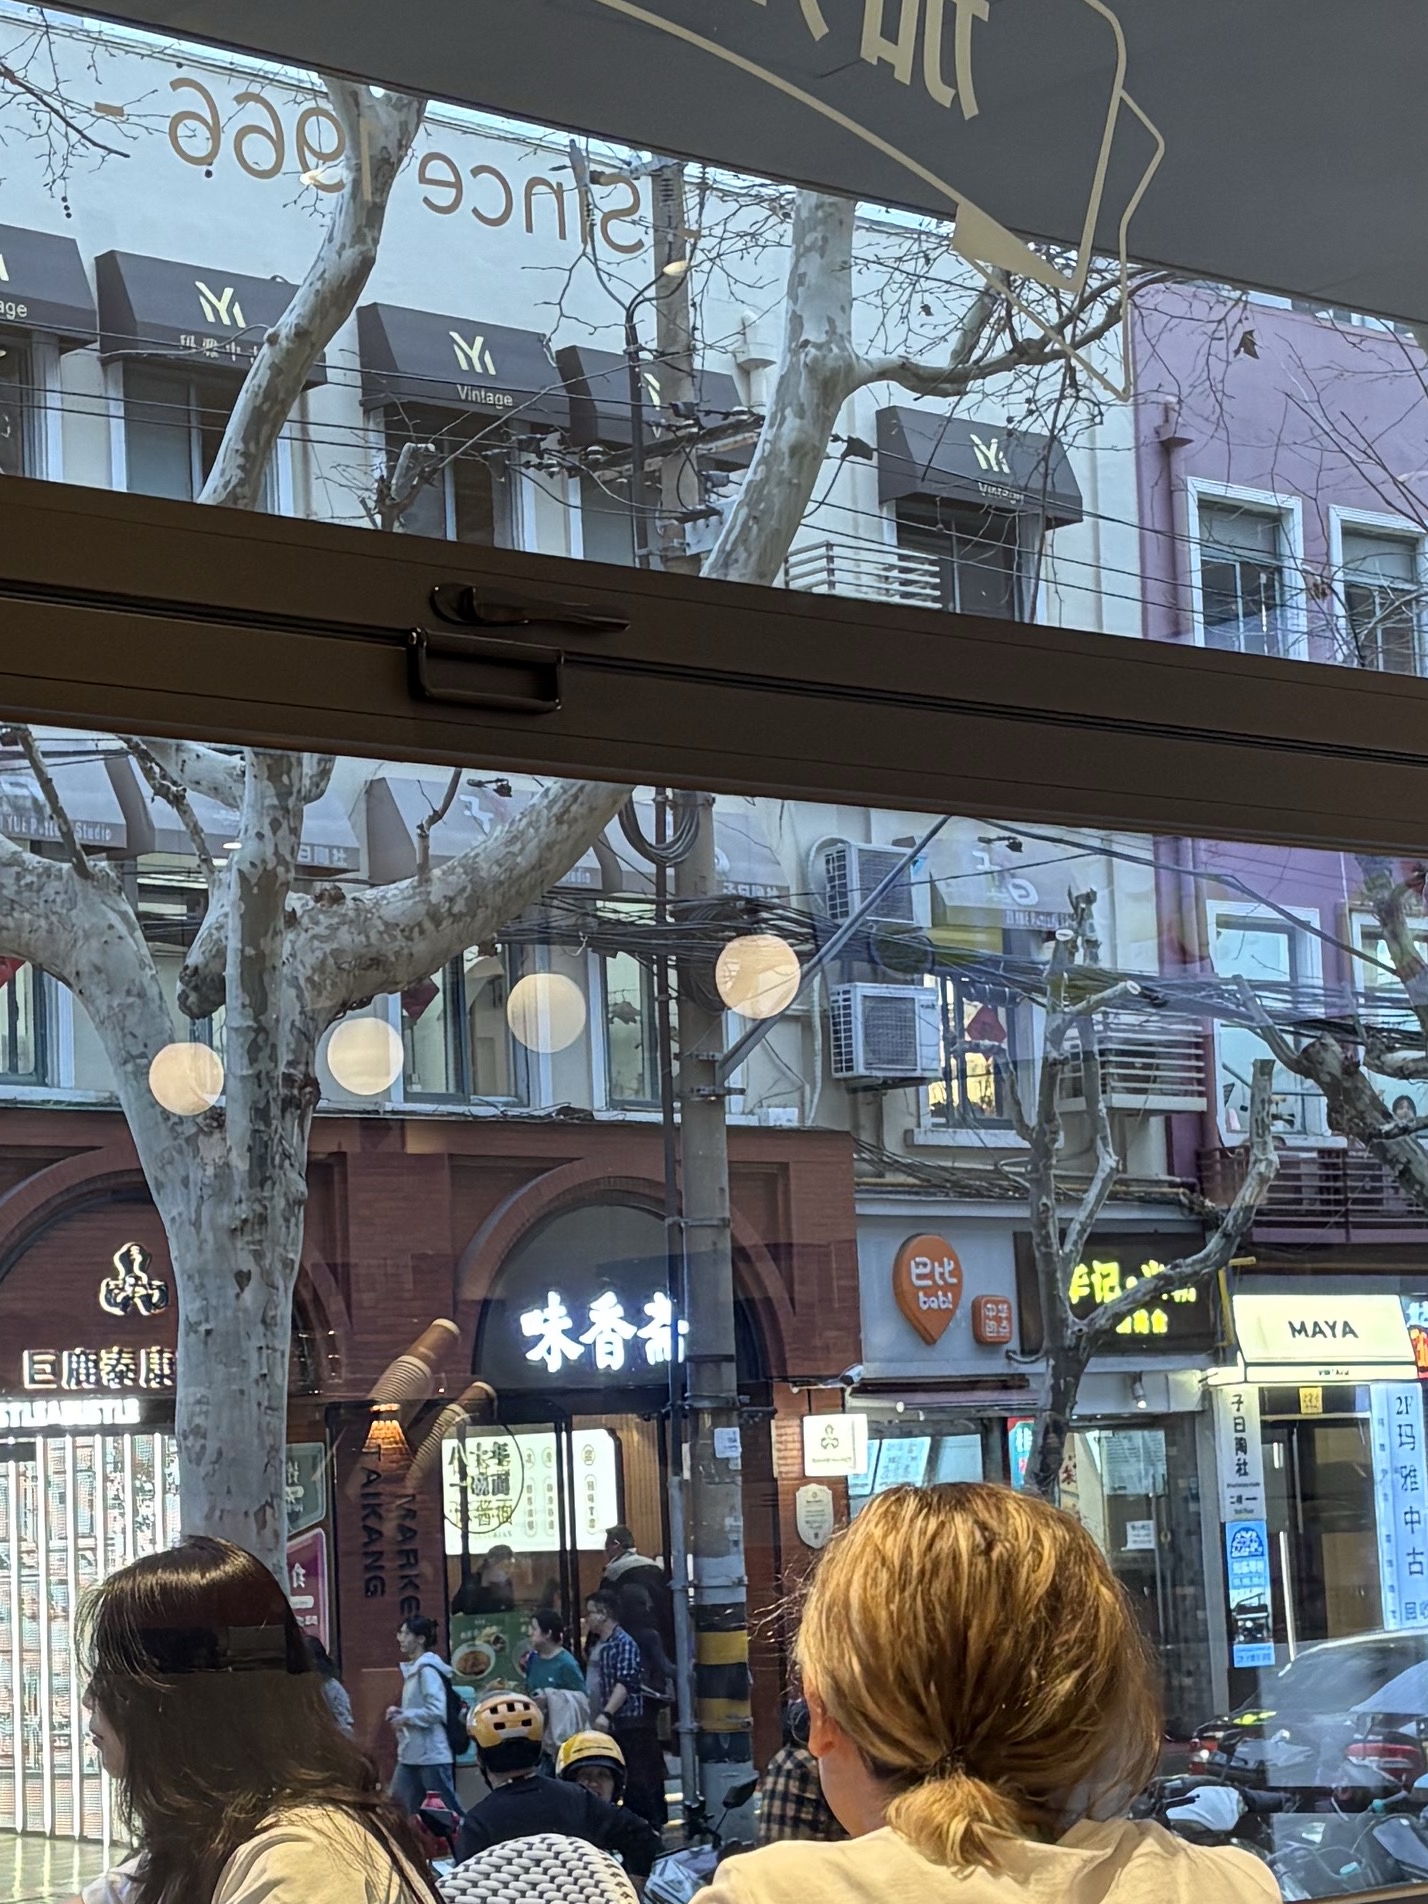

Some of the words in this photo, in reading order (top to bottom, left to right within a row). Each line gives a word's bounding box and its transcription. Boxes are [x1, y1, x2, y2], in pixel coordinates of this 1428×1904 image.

[456, 383, 514, 410] Vintage
[75, 821, 113, 843] Studio
[910, 1256, 959, 1287] 巴比
[1288, 1319, 1360, 1340] MAYA
[1395, 1395, 1414, 1416] 2F
[1397, 1422, 1425, 1577] 玛雅中古
[360, 1443, 387, 1599] TAIKANG
[394, 1493, 422, 1618] MARKE
